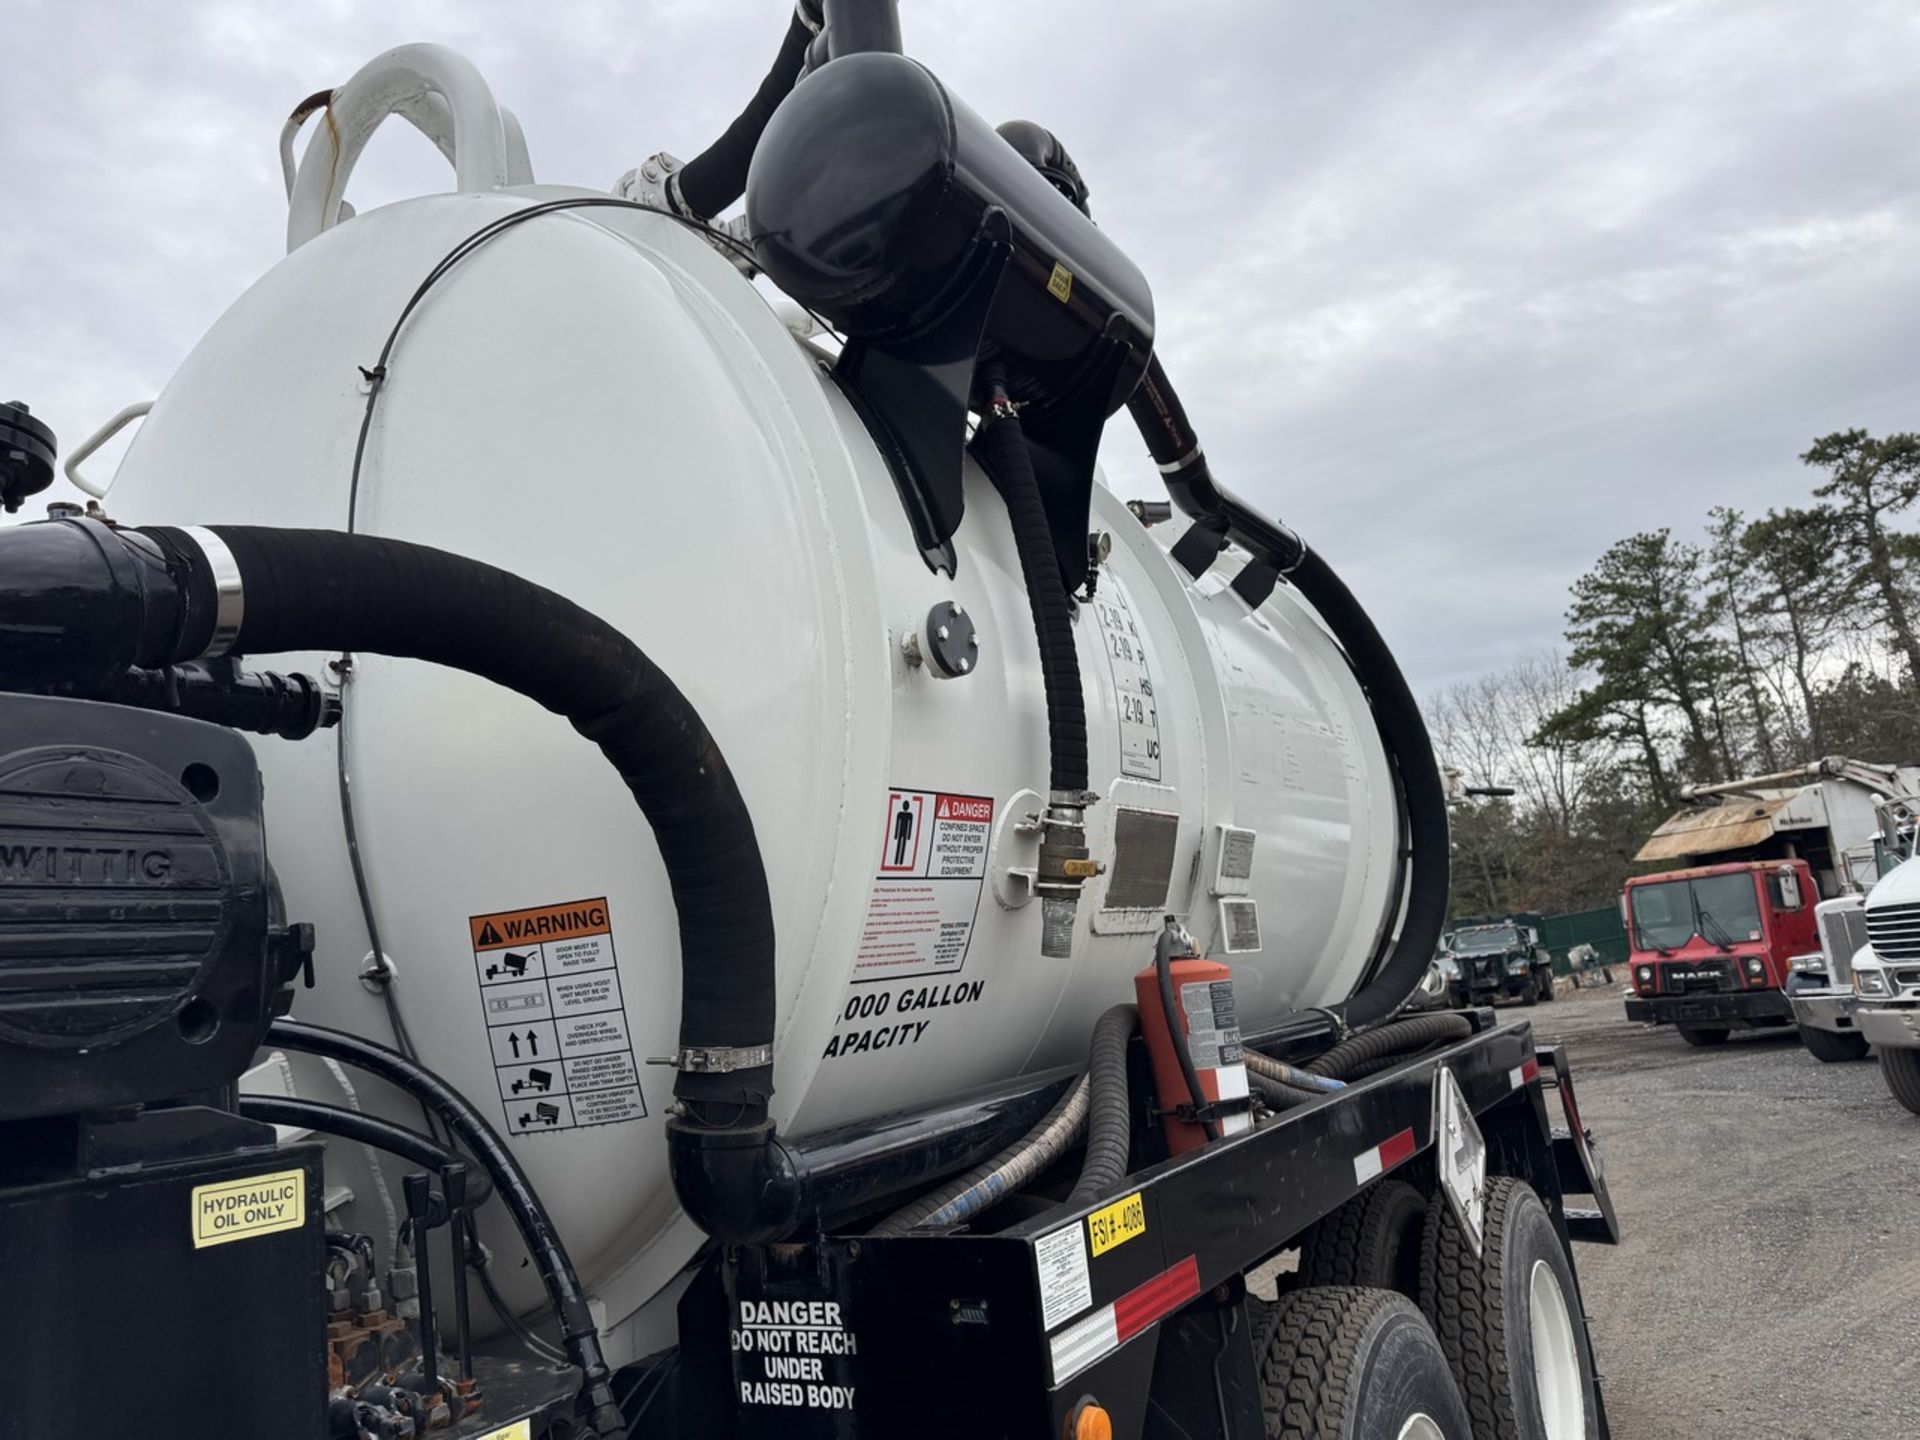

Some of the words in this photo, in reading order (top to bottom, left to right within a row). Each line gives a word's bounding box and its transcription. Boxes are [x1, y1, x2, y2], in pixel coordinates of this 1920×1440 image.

[1123, 695, 1144, 724] 2-19
[1146, 739, 1159, 760] UC
[952, 802, 991, 818] DANGER
[939, 822, 968, 832] CONFINED
[969, 824, 986, 833] SPACE
[942, 833, 951, 842] DO
[952, 834, 963, 842] NOT
[0, 846, 172, 884] WITTIG
[941, 866, 973, 875] EQUIPMENT
[942, 855, 975, 864] PROTECTIVE
[504, 908, 606, 940] WARNING
[1671, 970, 1723, 979] MACK
[896, 980, 985, 1013] GALLON
[203, 1186, 294, 1215] HYDRAULIC
[214, 1213, 240, 1229] OIL
[244, 1204, 285, 1223] ONLY
[1092, 1216, 1110, 1249] FSI
[740, 1301, 843, 1326] DANGER
[731, 1329, 753, 1351] DO
[757, 1330, 792, 1352] NOT
[796, 1331, 857, 1355] REACH
[764, 1356, 824, 1381] UNDER
[740, 1381, 803, 1407] RAISED
[808, 1385, 855, 1410] BODY
